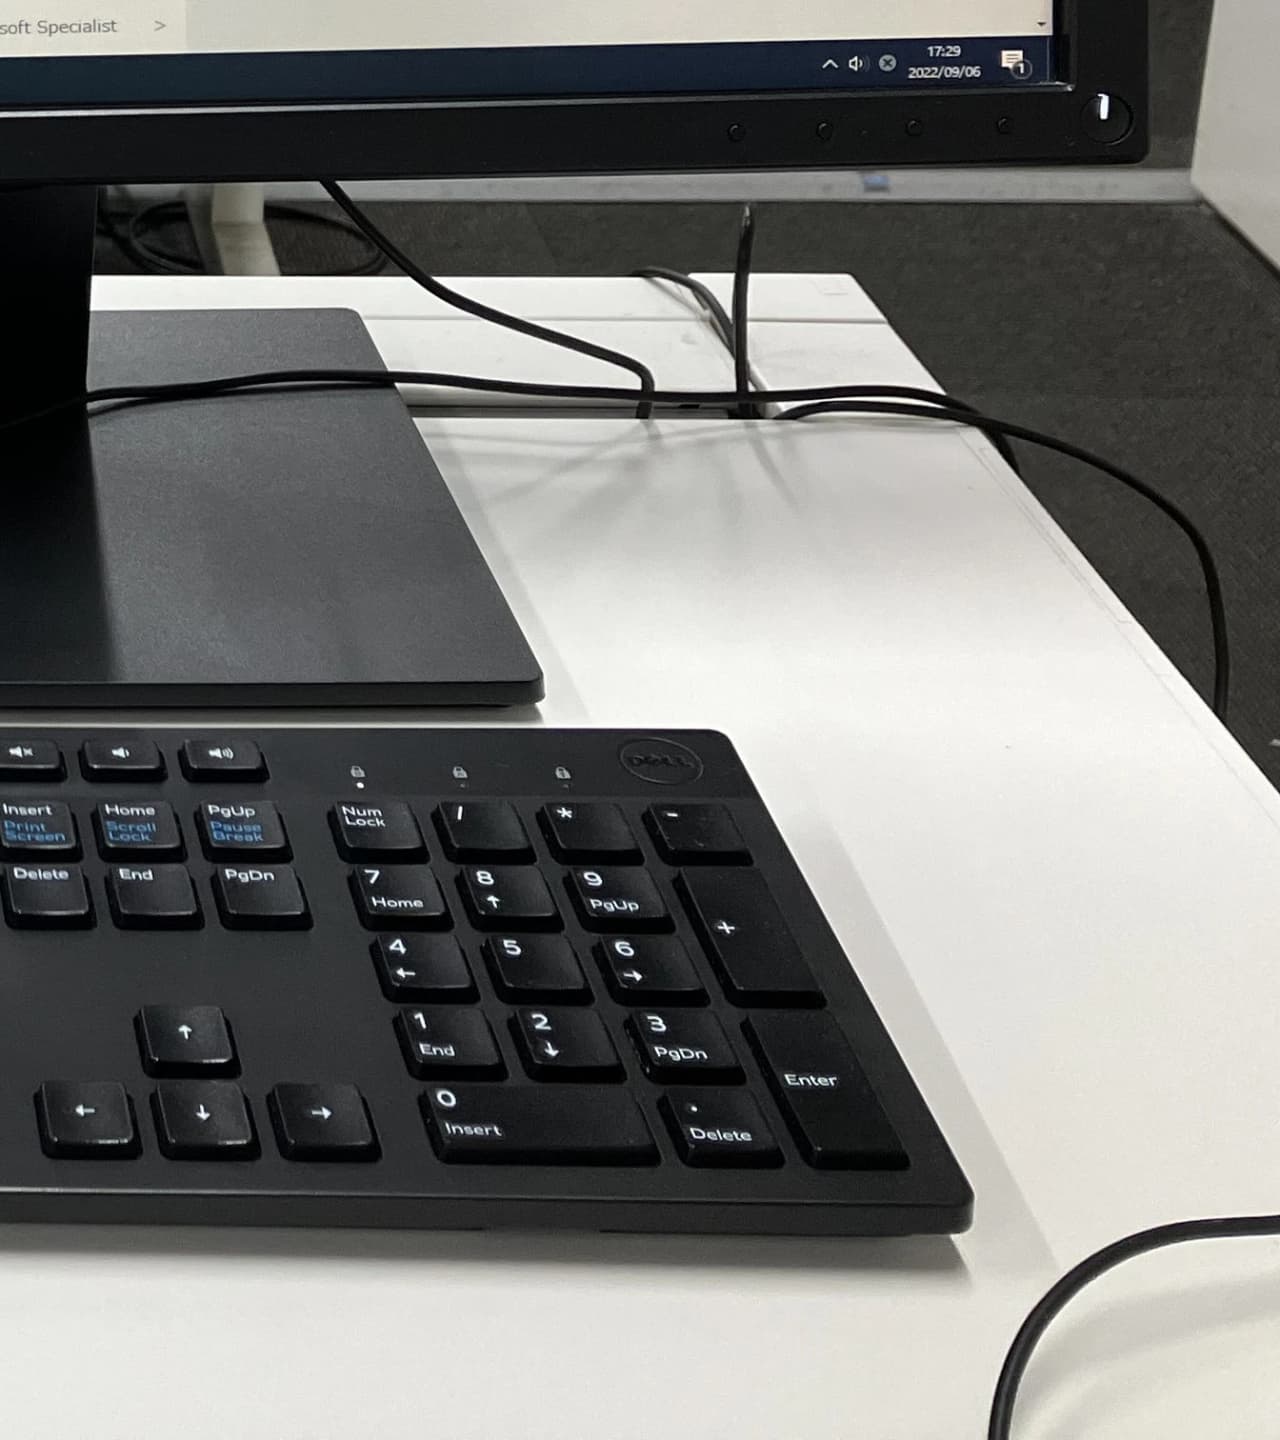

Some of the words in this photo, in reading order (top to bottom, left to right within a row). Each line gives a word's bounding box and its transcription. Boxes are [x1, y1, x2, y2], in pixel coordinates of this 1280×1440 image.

[37, 18, 119, 37] Specialist
[927, 45, 962, 57] 17:29
[908, 65, 982, 79] 2022/09/06
[2, 803, 53, 817] Insert
[105, 803, 156, 817] Home
[208, 804, 256, 819] PgUp
[342, 806, 382, 818] Num
[3, 820, 46, 833] Print
[105, 820, 157, 833] Scroll
[210, 821, 263, 833] Pause
[345, 816, 386, 828] Lock
[5, 830, 66, 843] Screen
[108, 831, 153, 843] Lock
[213, 831, 264, 843] Break
[13, 866, 70, 882] Delete
[119, 868, 154, 882] End
[224, 868, 275, 884] PgDn
[363, 869, 381, 885] 7
[583, 871, 604, 887] 9
[371, 896, 425, 910] Home
[589, 898, 640, 913] PgUp
[502, 940, 522, 957] 5
[413, 1012, 427, 1031] 1
[646, 1015, 667, 1033] 3
[419, 1042, 455, 1058] End
[654, 1046, 709, 1063] PgDn
[785, 1073, 839, 1089] Enter
[437, 1089, 458, 1108] 0
[444, 1122, 503, 1138] Insert
[689, 1126, 753, 1143] Delete
